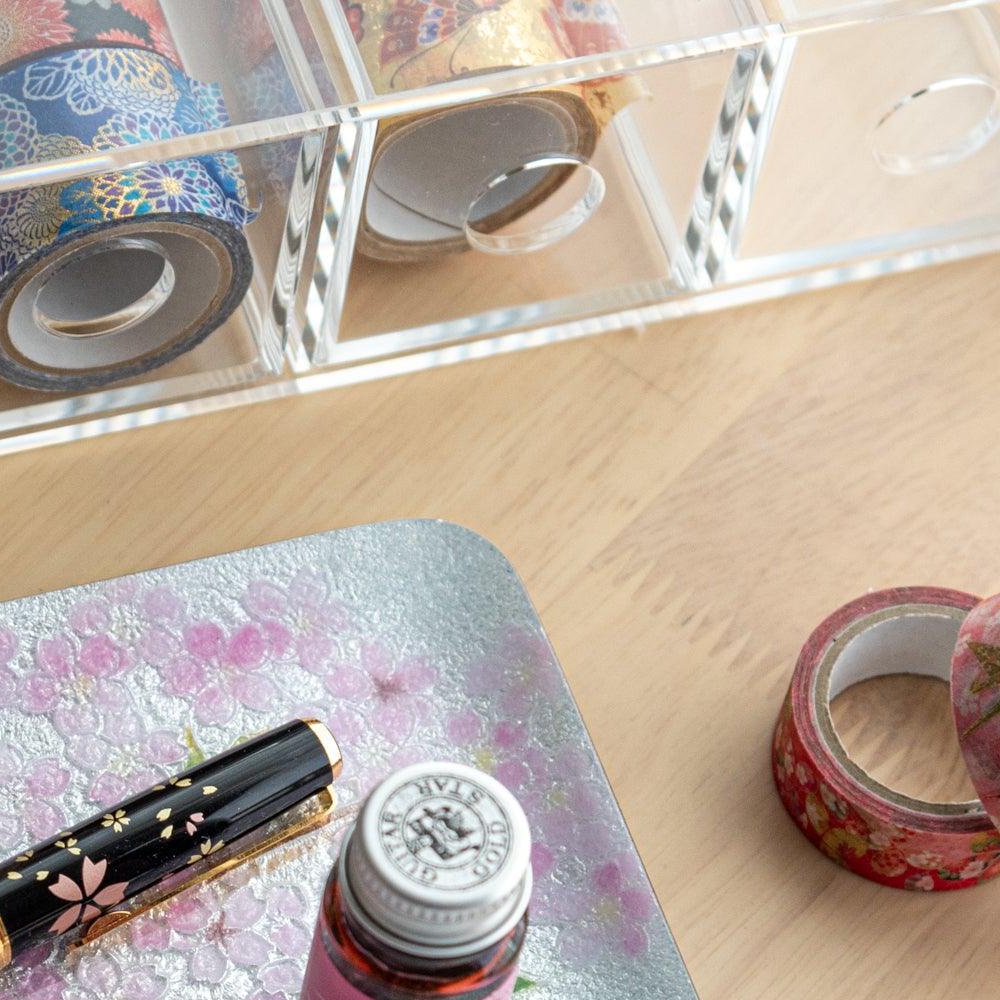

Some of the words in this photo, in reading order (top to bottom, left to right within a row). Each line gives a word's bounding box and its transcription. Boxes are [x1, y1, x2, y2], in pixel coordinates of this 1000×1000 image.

[412, 776, 486, 804] STAR
[380, 811, 438, 883] GUITAR
[472, 820, 507, 878] GOLD
